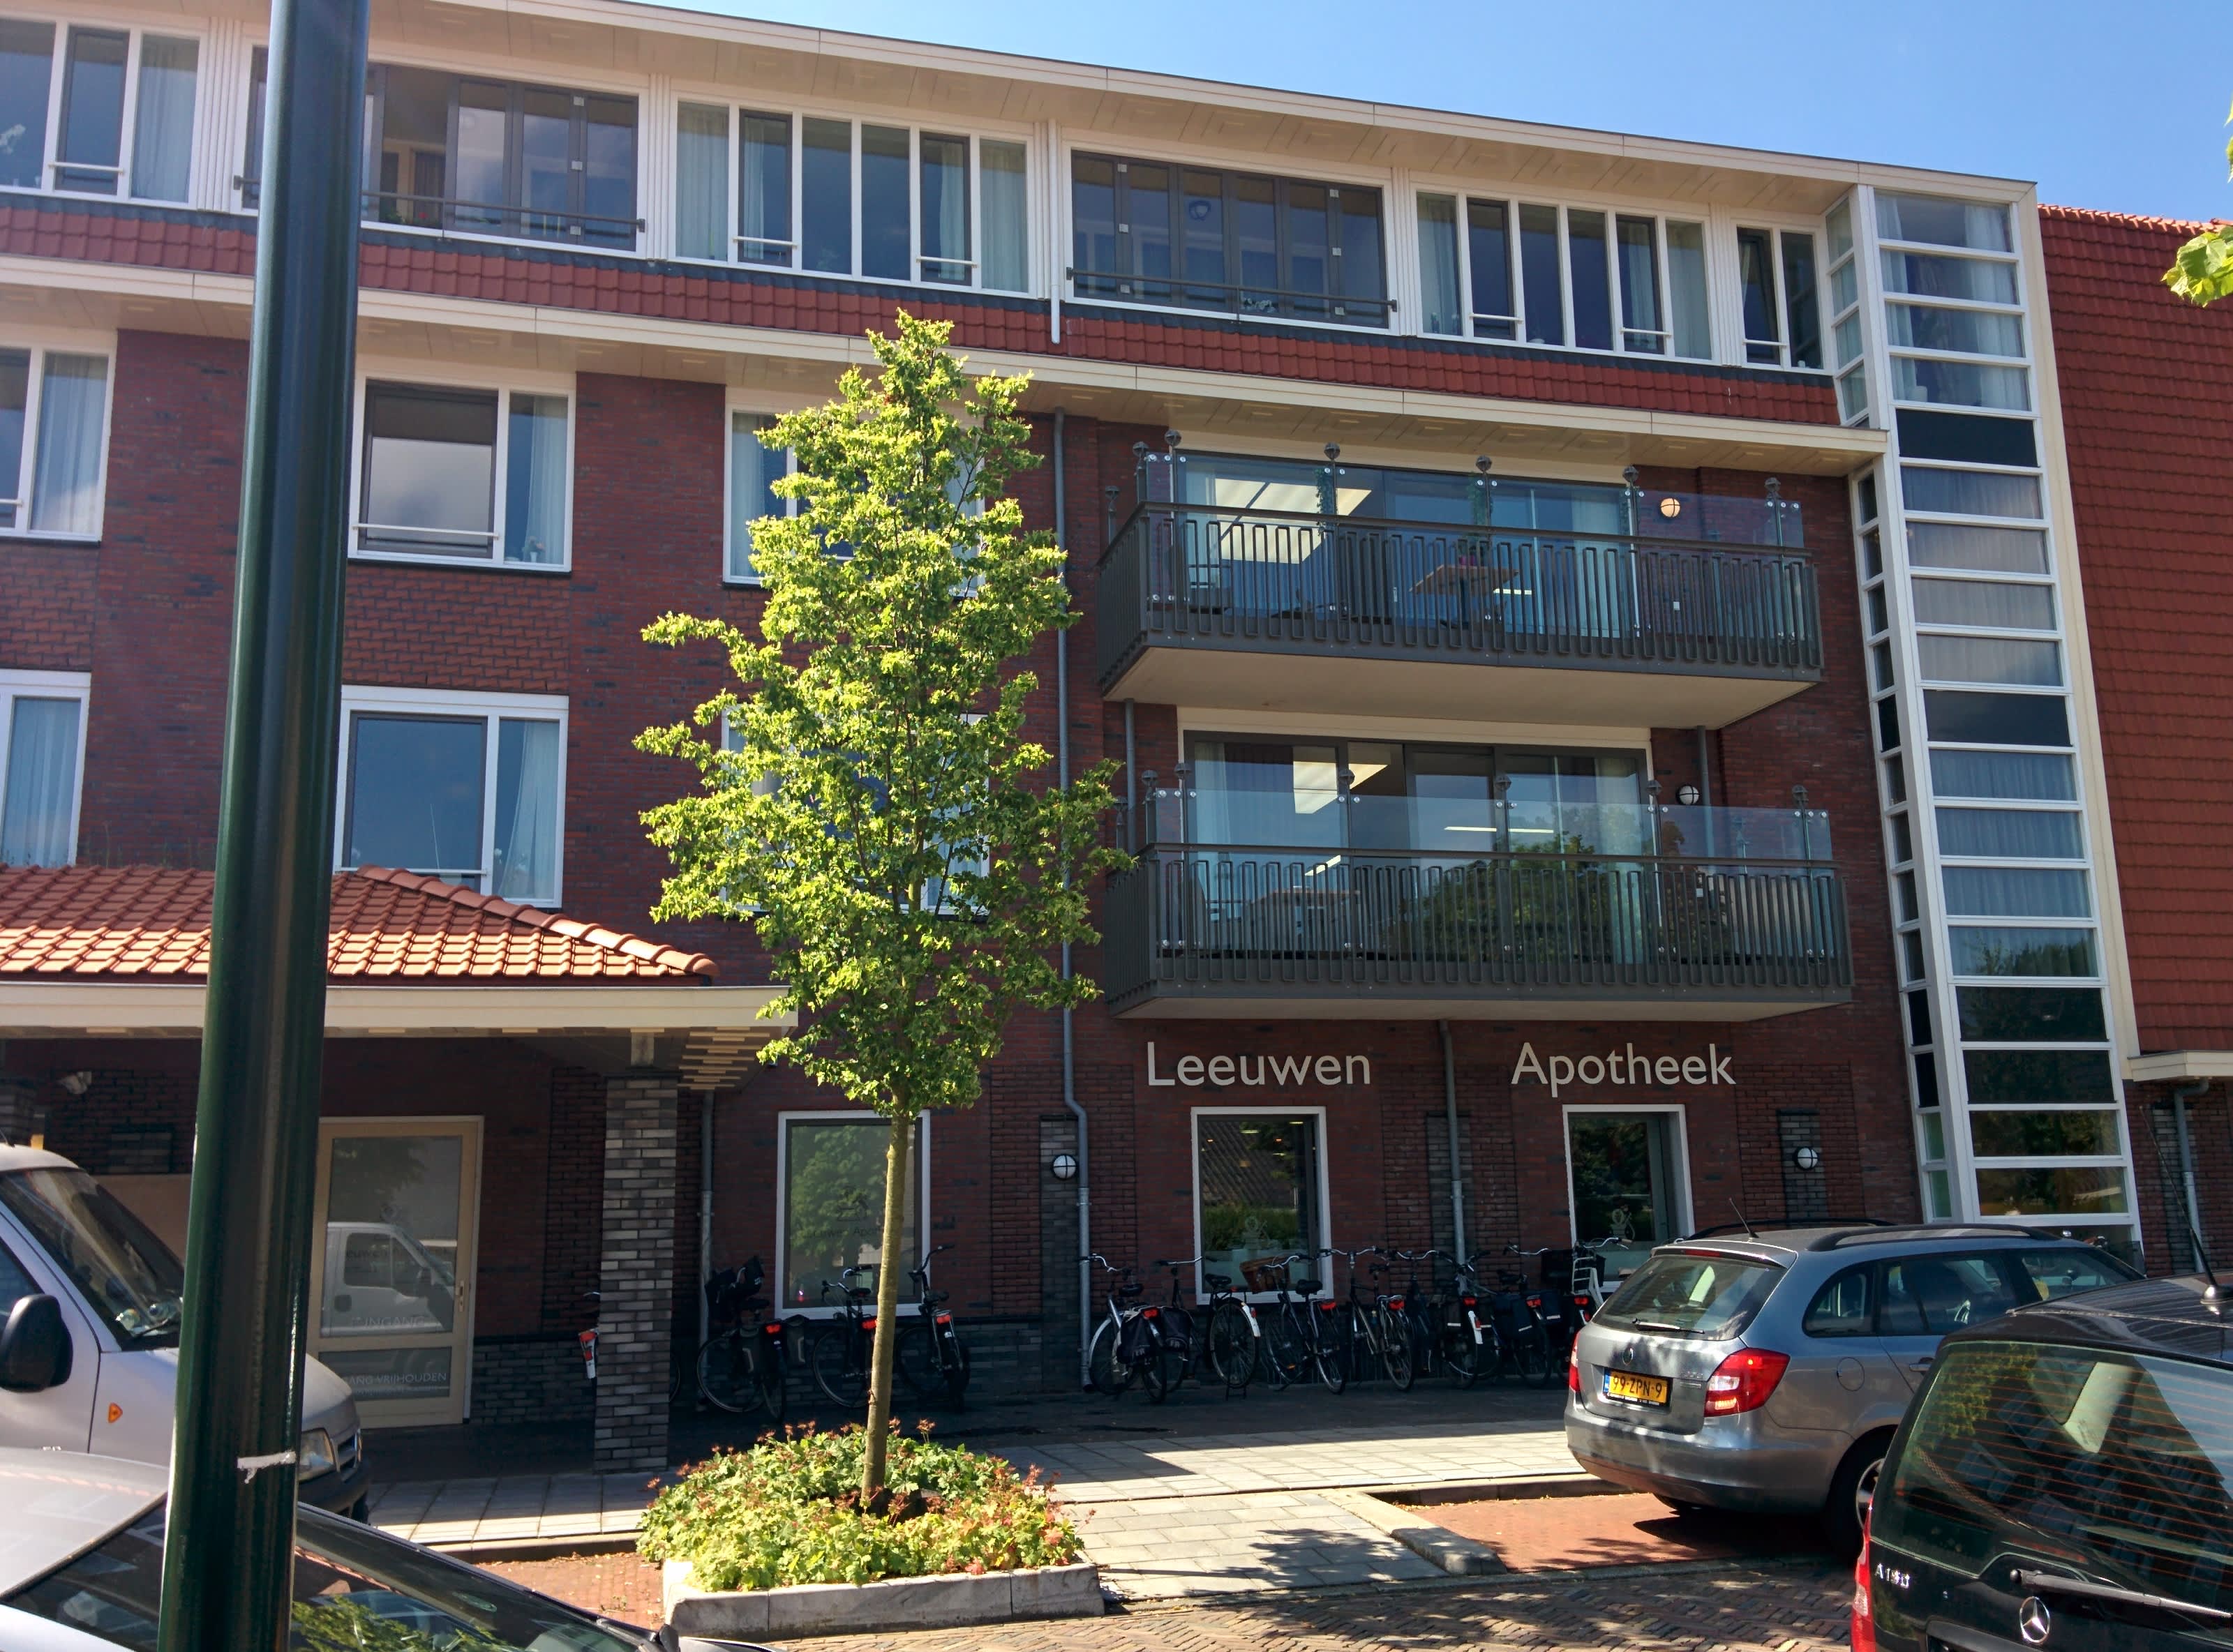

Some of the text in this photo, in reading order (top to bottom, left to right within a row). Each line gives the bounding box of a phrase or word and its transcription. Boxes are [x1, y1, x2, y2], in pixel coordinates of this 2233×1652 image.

[1147, 1041, 1736, 1098] Leeuwen Apotheek
[1613, 1376, 1663, 1398] 99-ZPN-9
